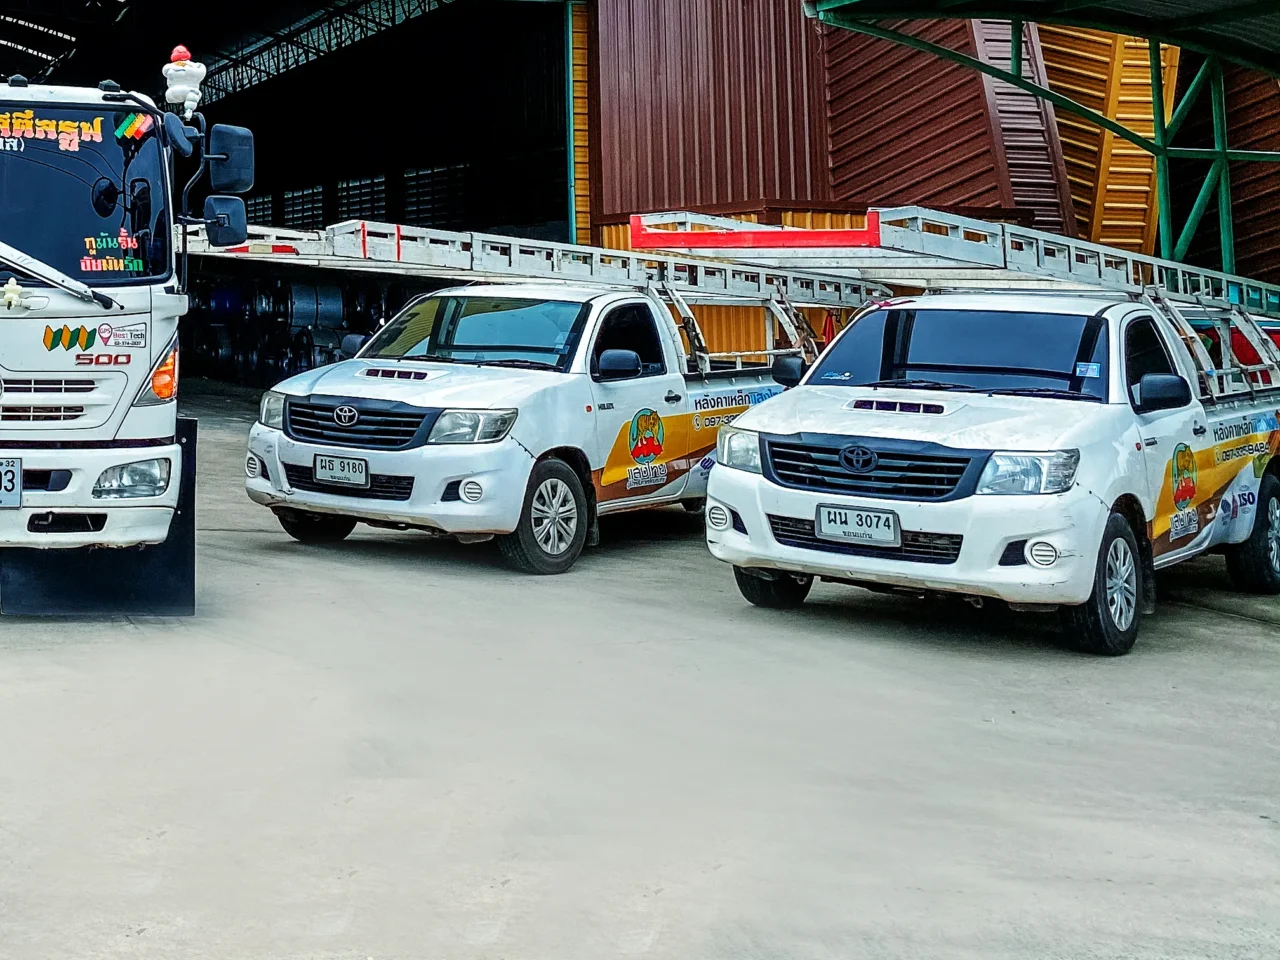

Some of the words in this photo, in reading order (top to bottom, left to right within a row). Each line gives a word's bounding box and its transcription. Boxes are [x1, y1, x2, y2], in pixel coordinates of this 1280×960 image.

[130, 331, 145, 339] Tech
[75, 354, 132, 366] 500
[339, 460, 363, 474] 9180
[1238, 491, 1256, 507] ISO
[856, 513, 891, 530] 3074
